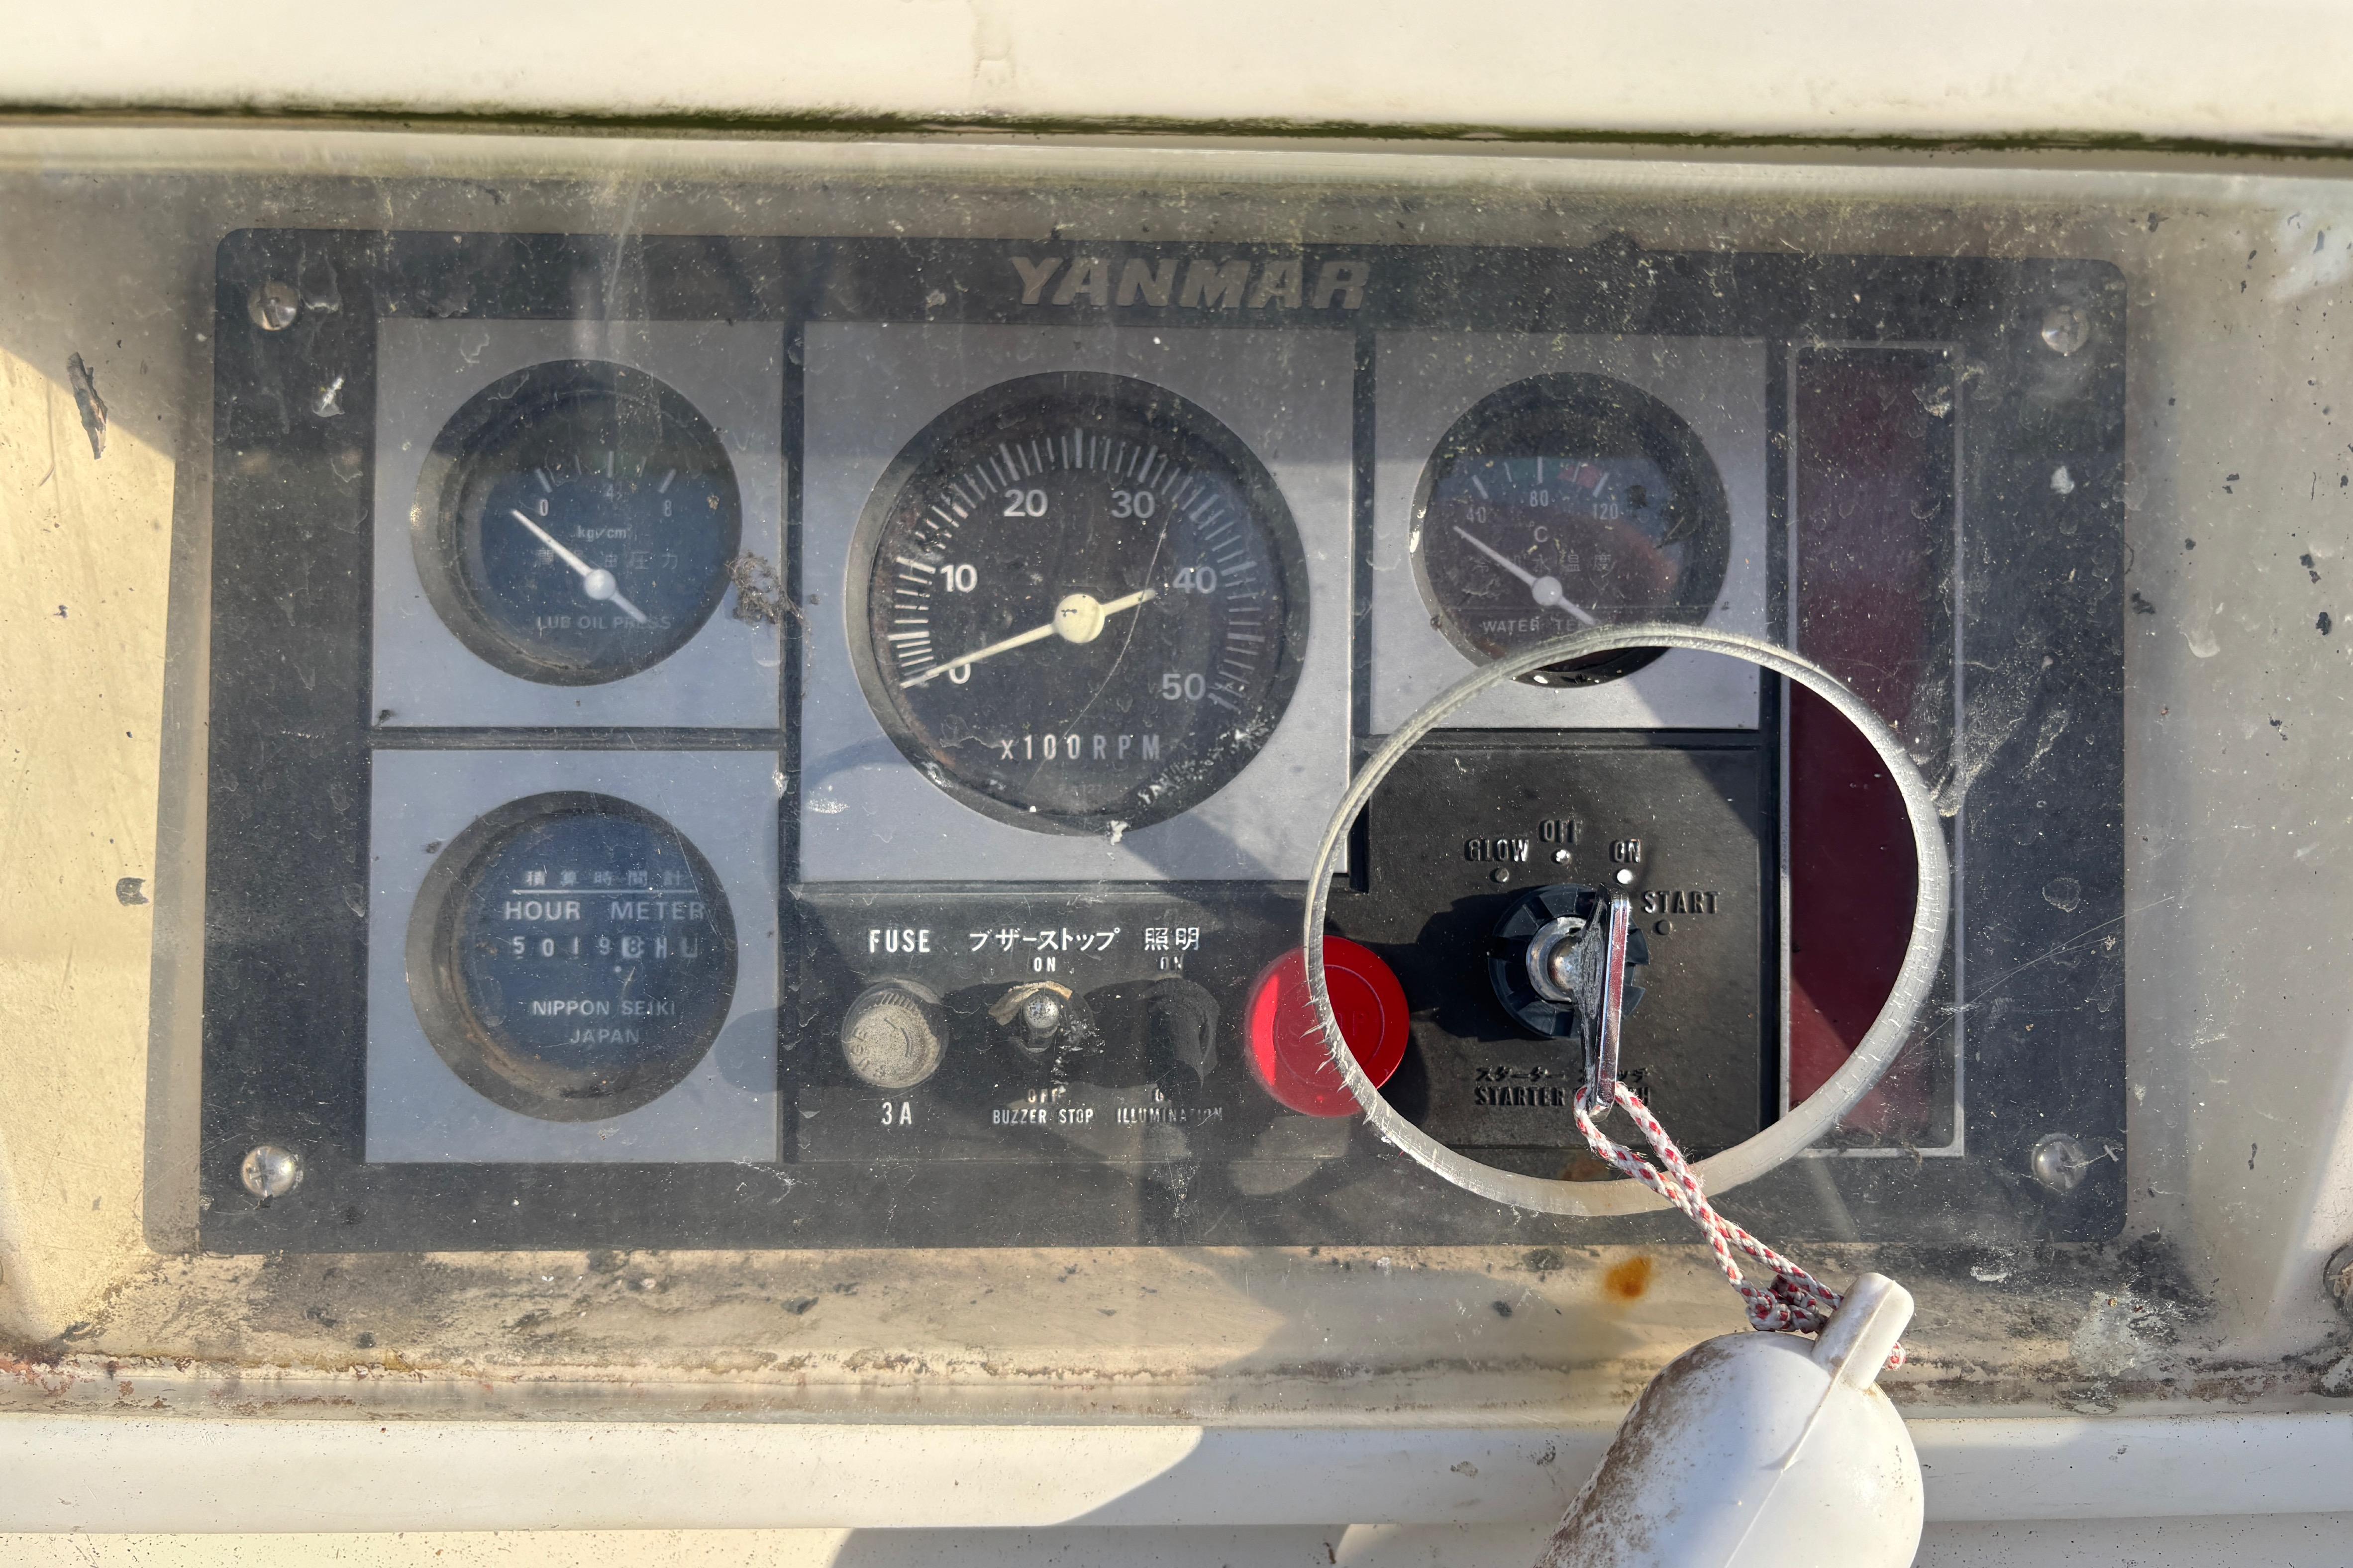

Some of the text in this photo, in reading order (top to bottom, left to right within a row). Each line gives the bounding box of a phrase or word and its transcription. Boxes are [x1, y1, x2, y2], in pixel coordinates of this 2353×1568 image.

[1012, 257, 1370, 309] YANMAR
[540, 499, 549, 516] 0
[663, 499, 672, 517] 8
[1003, 489, 1048, 517] 20
[1112, 490, 1155, 518] 30
[1530, 490, 1548, 507] 80
[1466, 506, 1487, 523] 40
[1593, 503, 1617, 520] 120
[940, 564, 978, 592] 10
[1172, 567, 1217, 594] 40
[577, 616, 607, 629] OIL
[1482, 620, 1539, 632] WATER
[948, 659, 971, 685] 0
[1162, 674, 1207, 700] 50
[1542, 819, 1582, 845] OFF
[1466, 838, 1530, 862] GLOW
[1611, 839, 1641, 863] ON
[505, 900, 705, 921] HOUR METER
[1642, 890, 1720, 914] START
[869, 929, 931, 954] FUSE
[969, 927, 1121, 952] ブザーストップ
[1144, 926, 1200, 951] 照明
[1034, 956, 1056, 973] ON
[1160, 956, 1184, 972] ON
[532, 1000, 676, 1016] NIPPON SEIKI
[570, 1028, 640, 1044] JAPAN
[1474, 1086, 1566, 1106] STARTER
[882, 1102, 913, 1126] 3A
[993, 1108, 1094, 1124] BUZZER STOP
